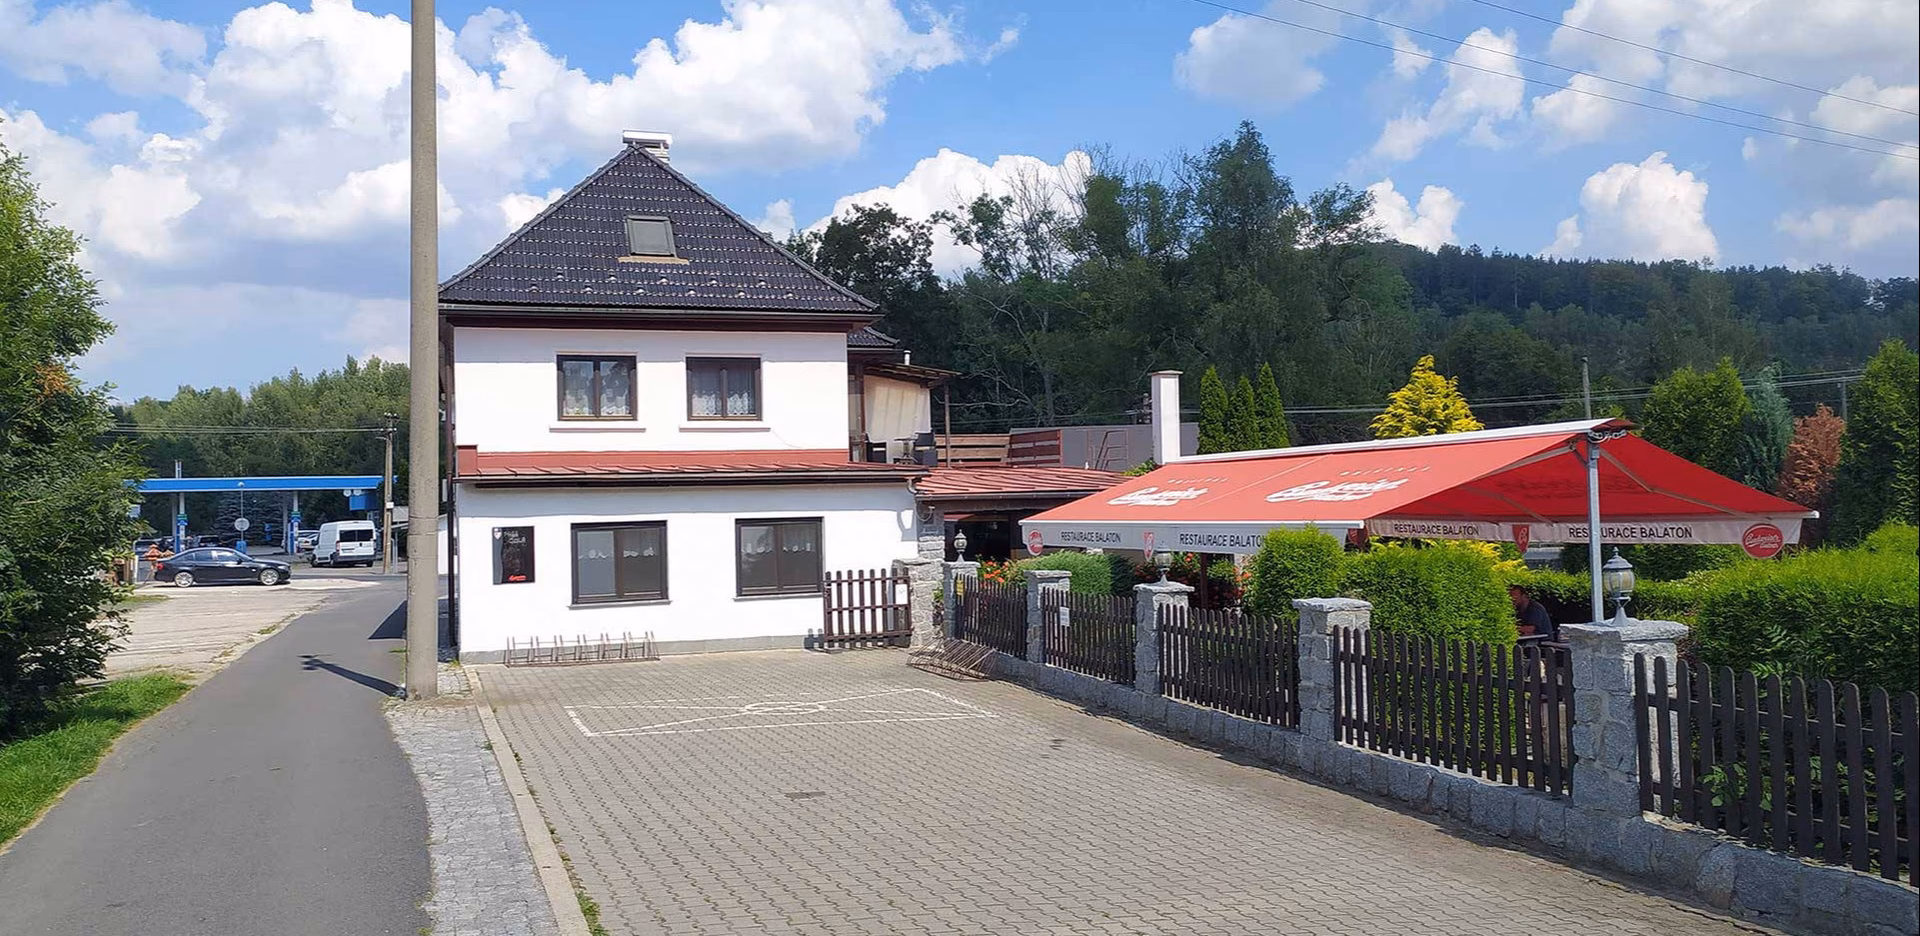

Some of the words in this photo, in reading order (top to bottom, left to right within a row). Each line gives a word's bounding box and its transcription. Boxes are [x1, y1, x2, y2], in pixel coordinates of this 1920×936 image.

[1393, 523, 1442, 535] RESTAURACE
[1442, 525, 1479, 536] BALATON
[1568, 527, 1637, 539] RESURACE
[1640, 526, 1693, 538] BALATON
[1061, 531, 1095, 543] RESTAURACE
[1095, 531, 1122, 543] BALATON
[1179, 533, 1227, 547] RESTAURACE
